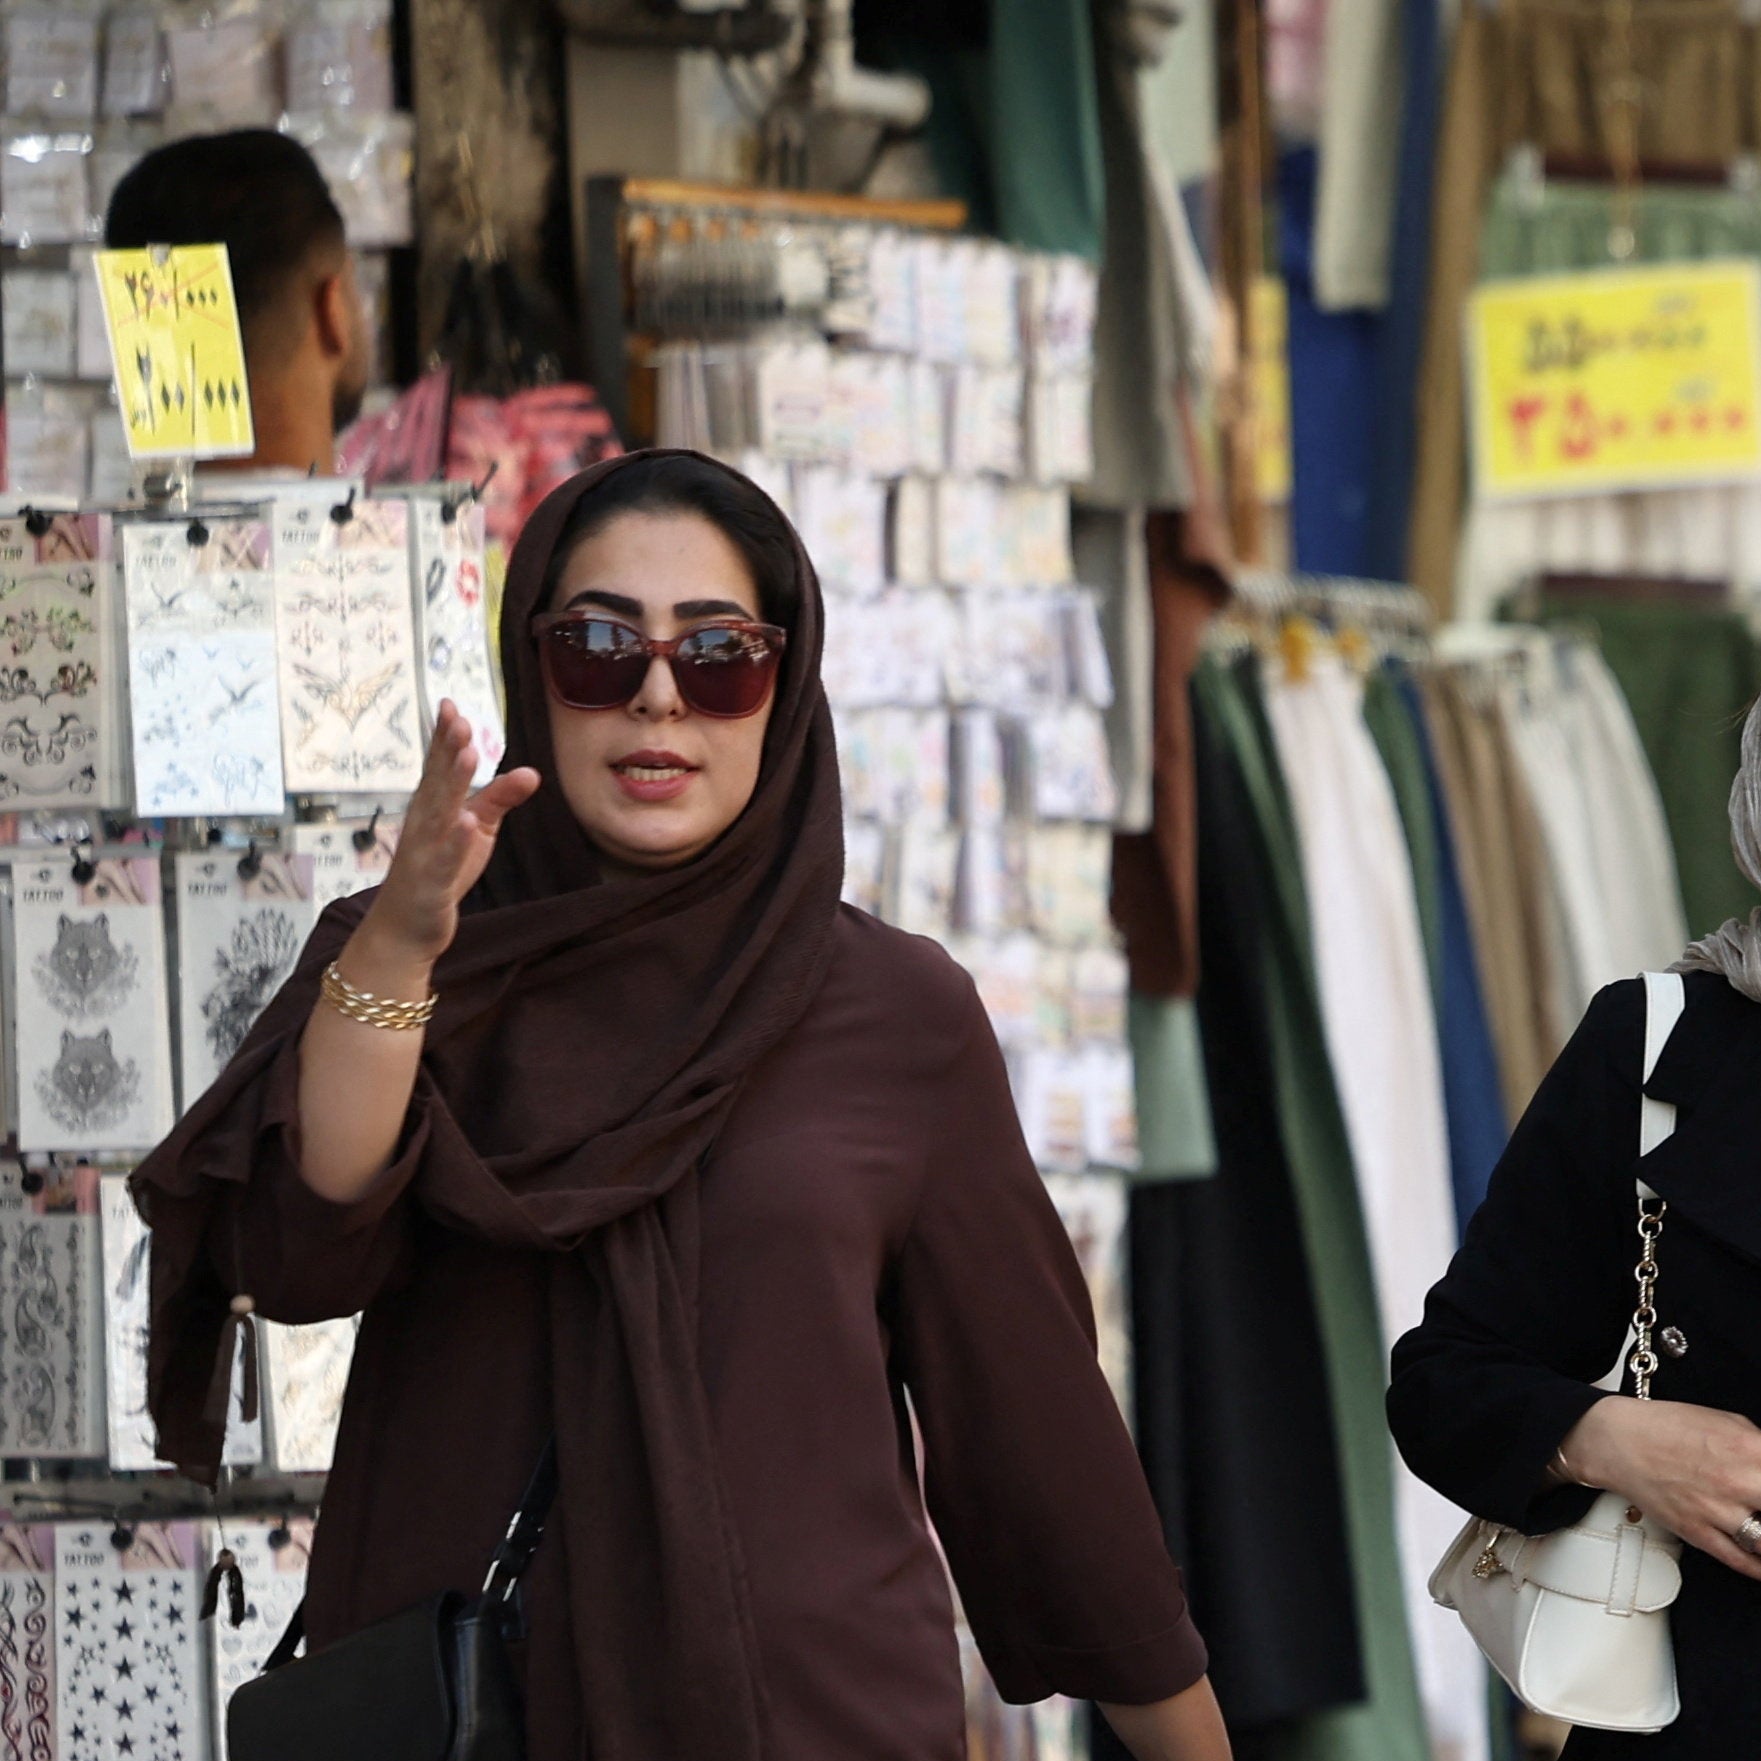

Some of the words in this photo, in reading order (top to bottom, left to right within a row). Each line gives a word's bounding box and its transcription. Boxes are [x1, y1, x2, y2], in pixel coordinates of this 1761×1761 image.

[23, 887, 64, 903] TATTOO
[187, 882, 228, 897] TATTOO
[64, 1553, 105, 1567] TATTOO
